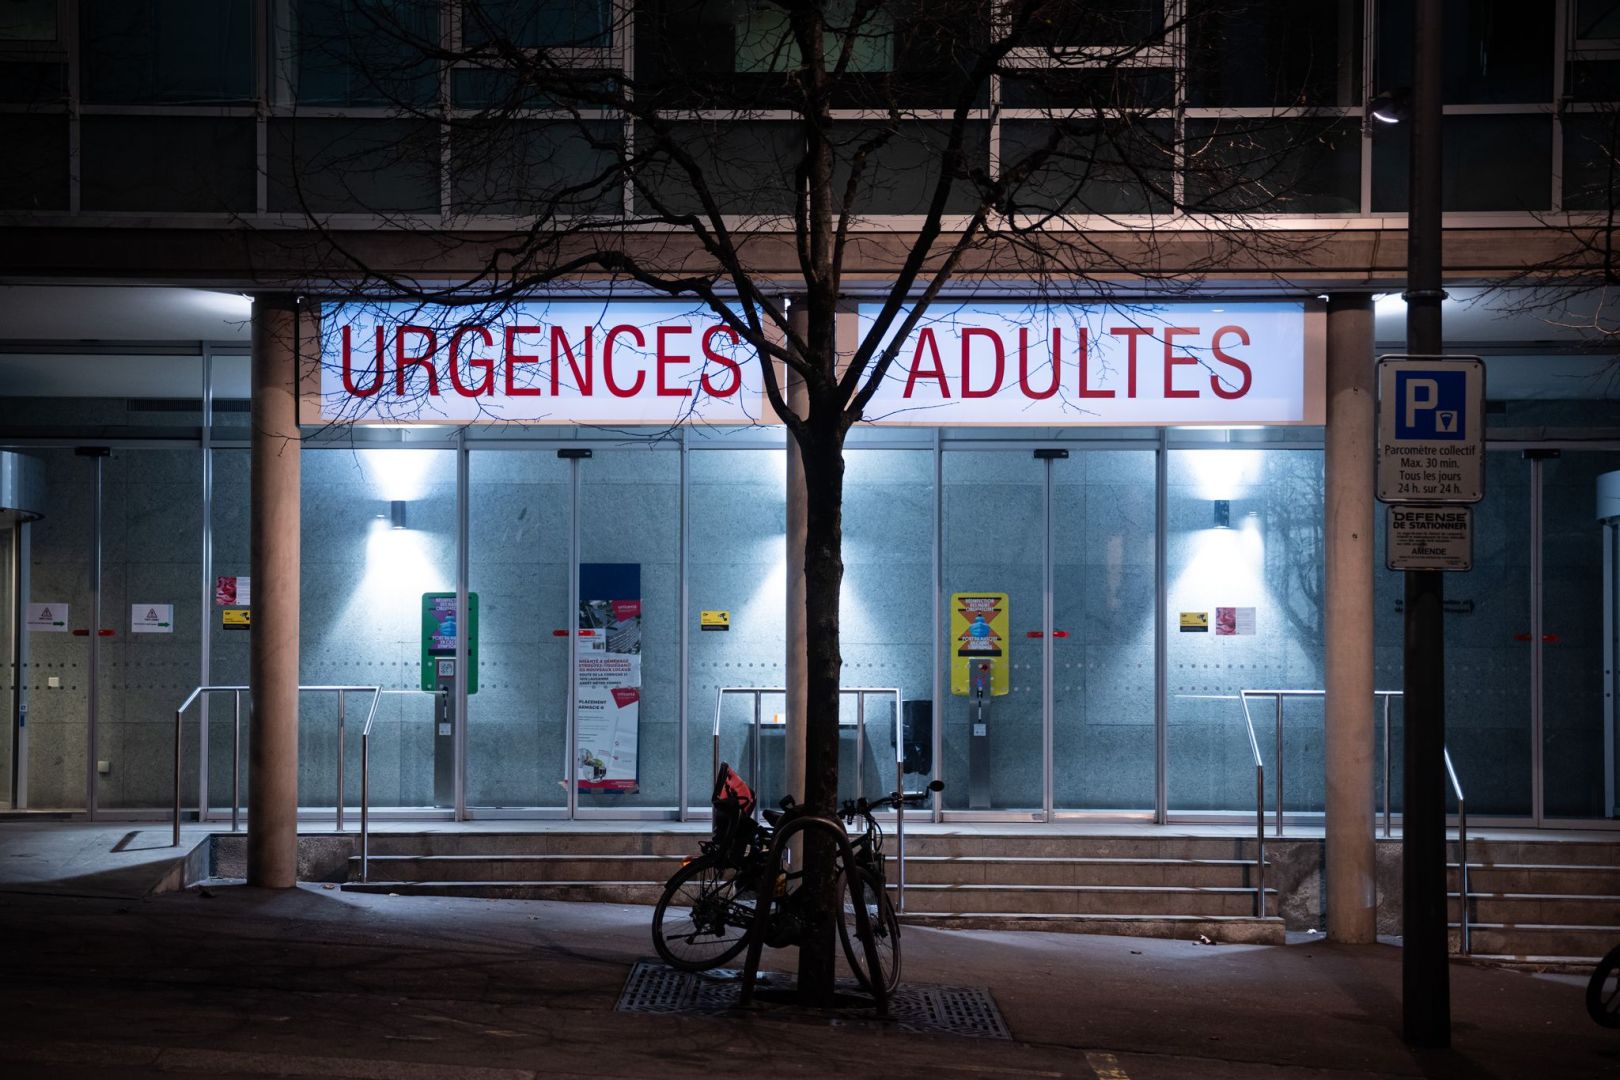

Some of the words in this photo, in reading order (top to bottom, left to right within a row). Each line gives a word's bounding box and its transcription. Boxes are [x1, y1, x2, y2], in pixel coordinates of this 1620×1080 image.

[342, 325, 741, 398] URGENCES
[903, 325, 1251, 399] ADULTES
[1406, 378, 1438, 428] P
[1384, 445, 1437, 456] Parcomètre
[1440, 445, 1476, 456] collectif
[1400, 458, 1423, 468] Max.
[1426, 458, 1437, 468] 30
[1440, 458, 1459, 468] min.
[1400, 470, 1420, 480] Tous
[1424, 470, 1436, 480] les
[1438, 471, 1462, 483] jours
[1398, 484, 1409, 493] 24
[1412, 484, 1420, 493] h.
[1440, 484, 1451, 493] 24
[1454, 484, 1462, 494] h.
